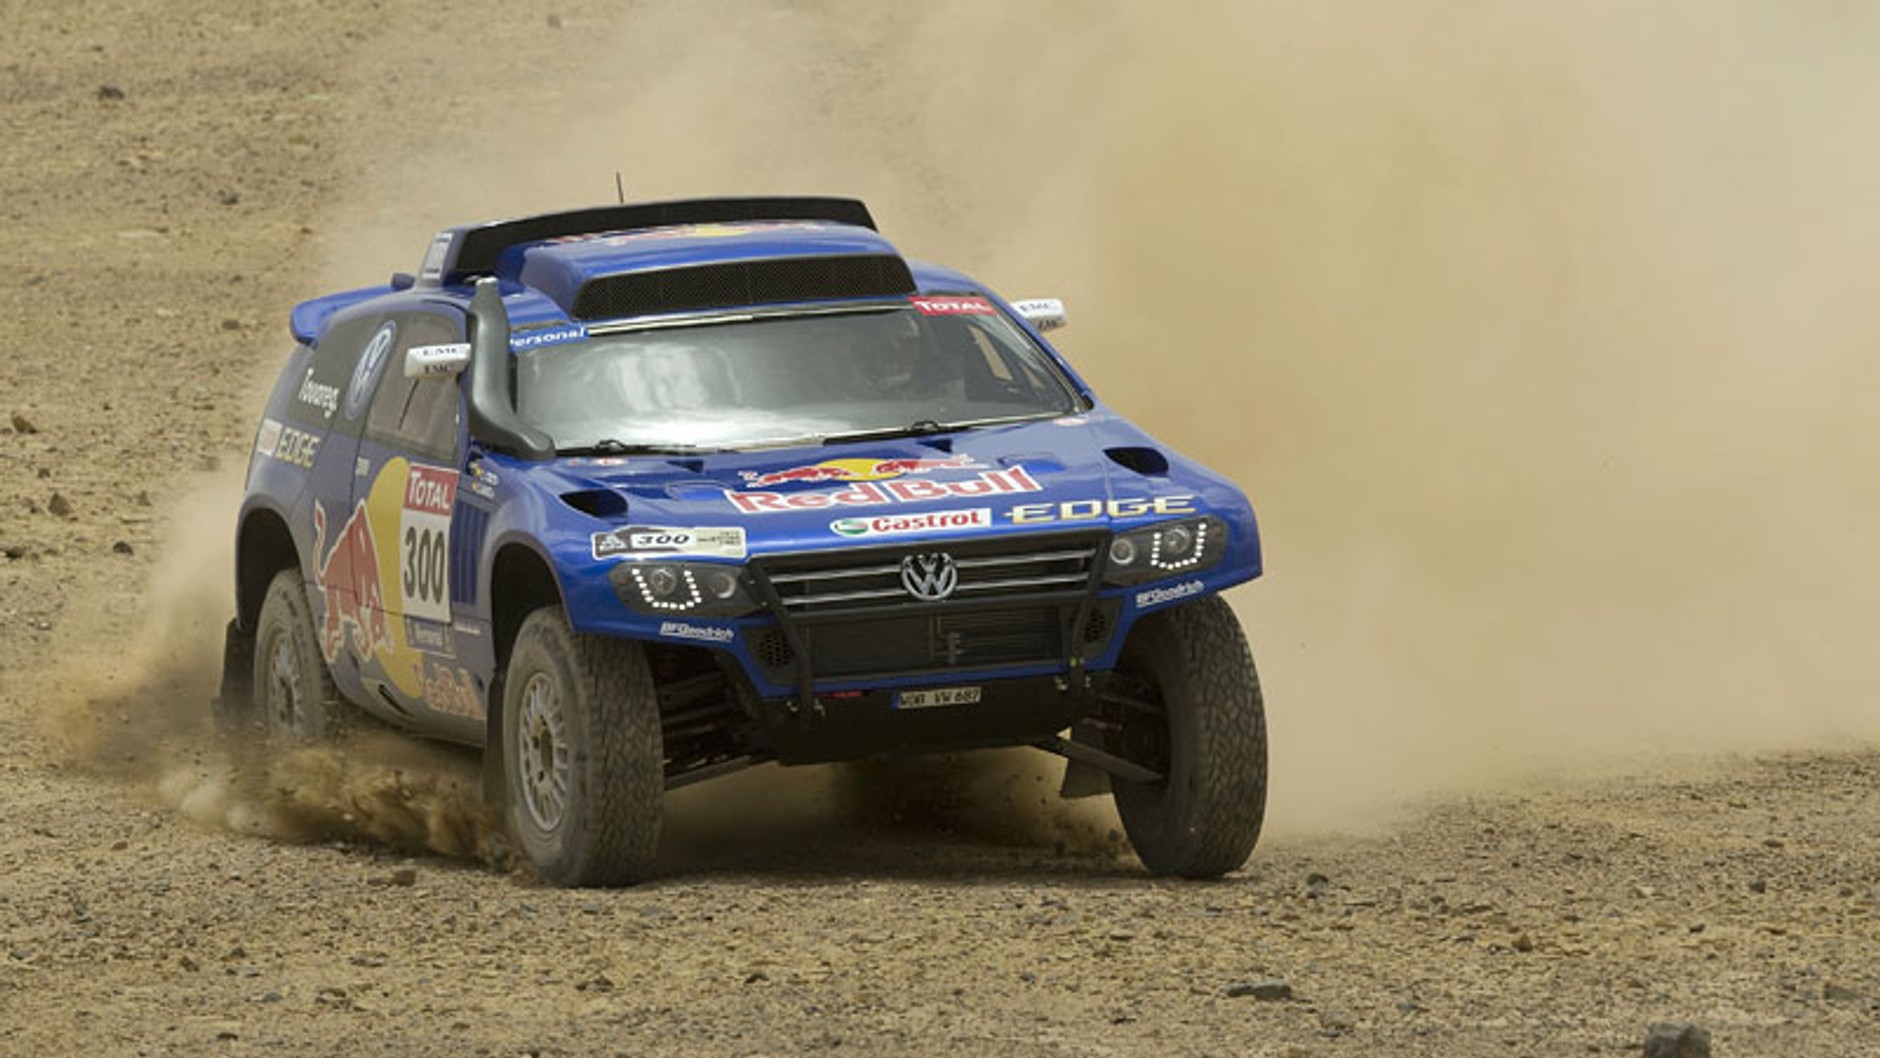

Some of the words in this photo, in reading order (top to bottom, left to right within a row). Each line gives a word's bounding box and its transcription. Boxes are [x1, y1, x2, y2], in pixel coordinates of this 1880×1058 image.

[914, 300, 992, 314] TOTAL
[409, 471, 452, 510] TOTAL
[725, 483, 890, 513] Red
[886, 464, 1042, 502] Bull
[872, 511, 982, 532] Castrol
[1005, 495, 1196, 524] EDGE
[637, 534, 690, 544] 300
[403, 526, 447, 604] 300
